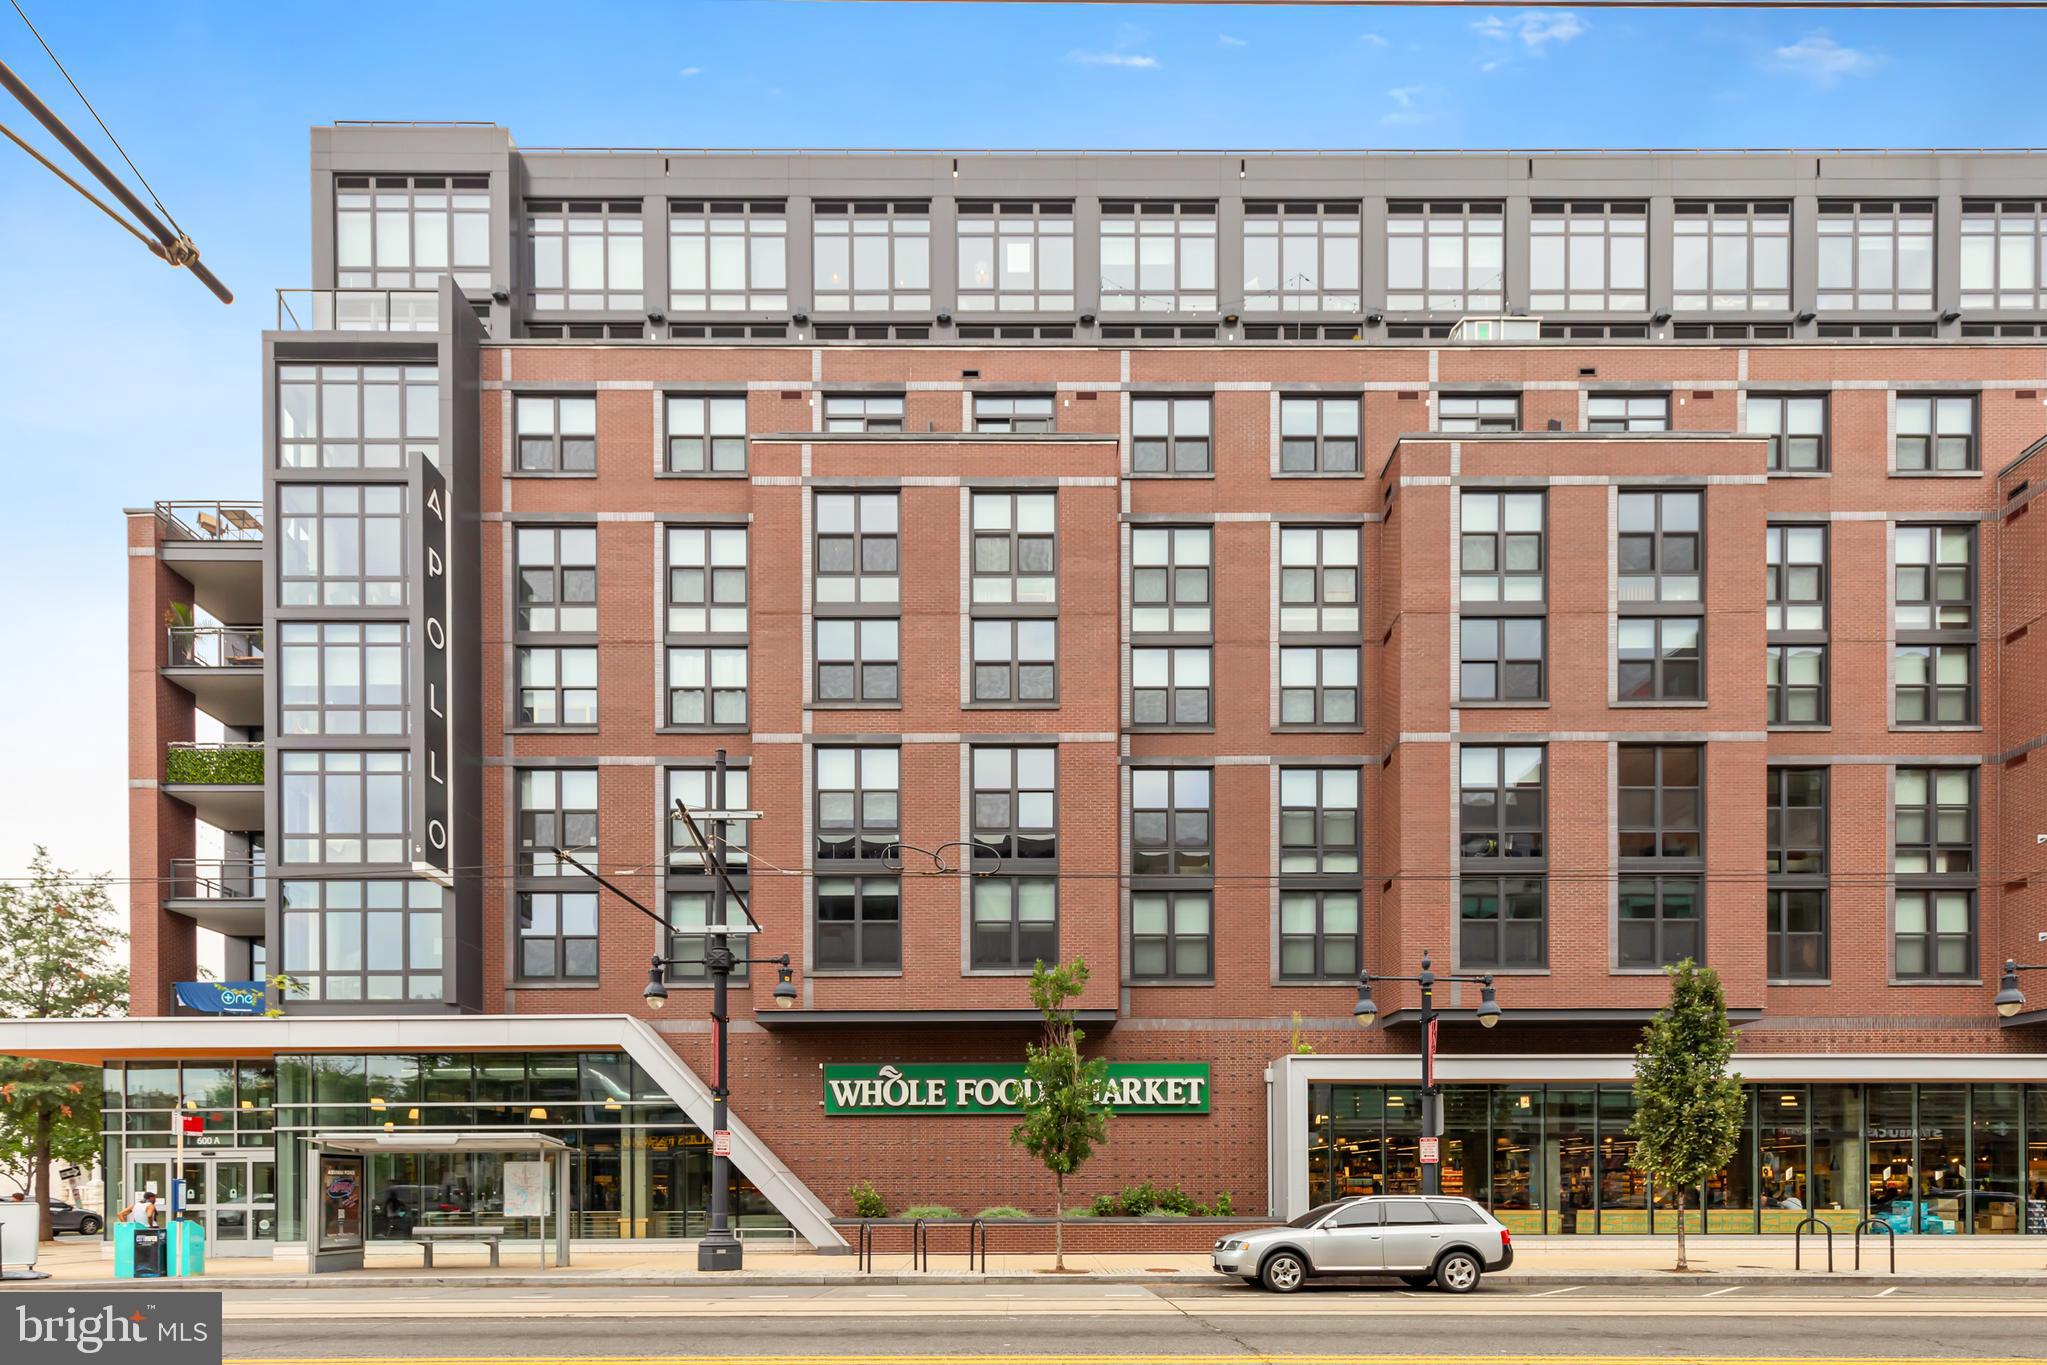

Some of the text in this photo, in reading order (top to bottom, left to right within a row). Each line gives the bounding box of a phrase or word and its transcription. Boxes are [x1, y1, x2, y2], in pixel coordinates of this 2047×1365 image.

[427, 488, 447, 851] APOLLO
[221, 990, 253, 1005] One
[828, 1065, 1205, 1107] WHOLE FOOD ARKET
[196, 1136, 221, 1145] 600 A
